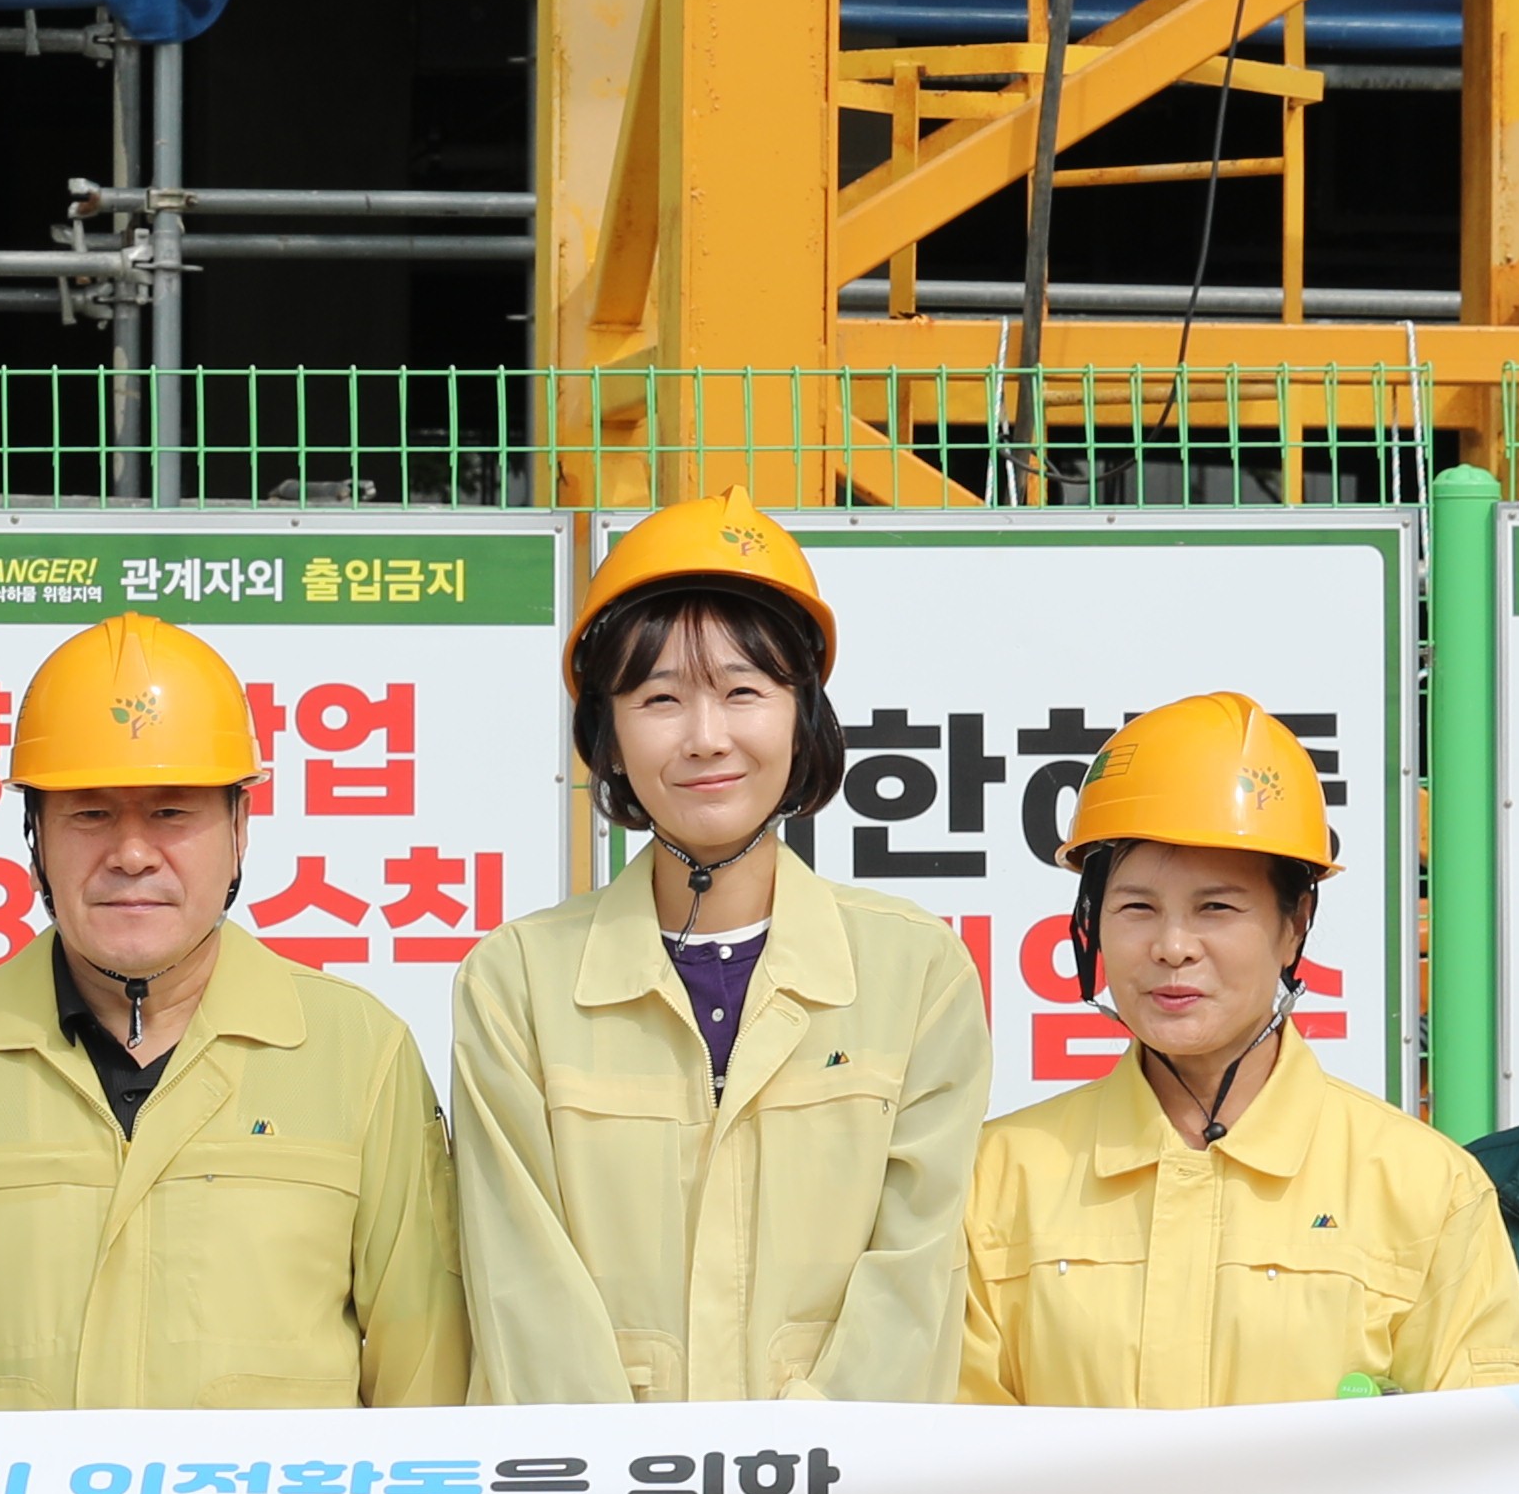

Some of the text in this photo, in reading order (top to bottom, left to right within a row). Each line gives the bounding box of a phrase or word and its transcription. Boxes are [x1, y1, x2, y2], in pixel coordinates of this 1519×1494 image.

[42, 585, 102, 603] 위험지역
[120, 558, 284, 603] 관계자외
[301, 557, 468, 603] 출입금지
